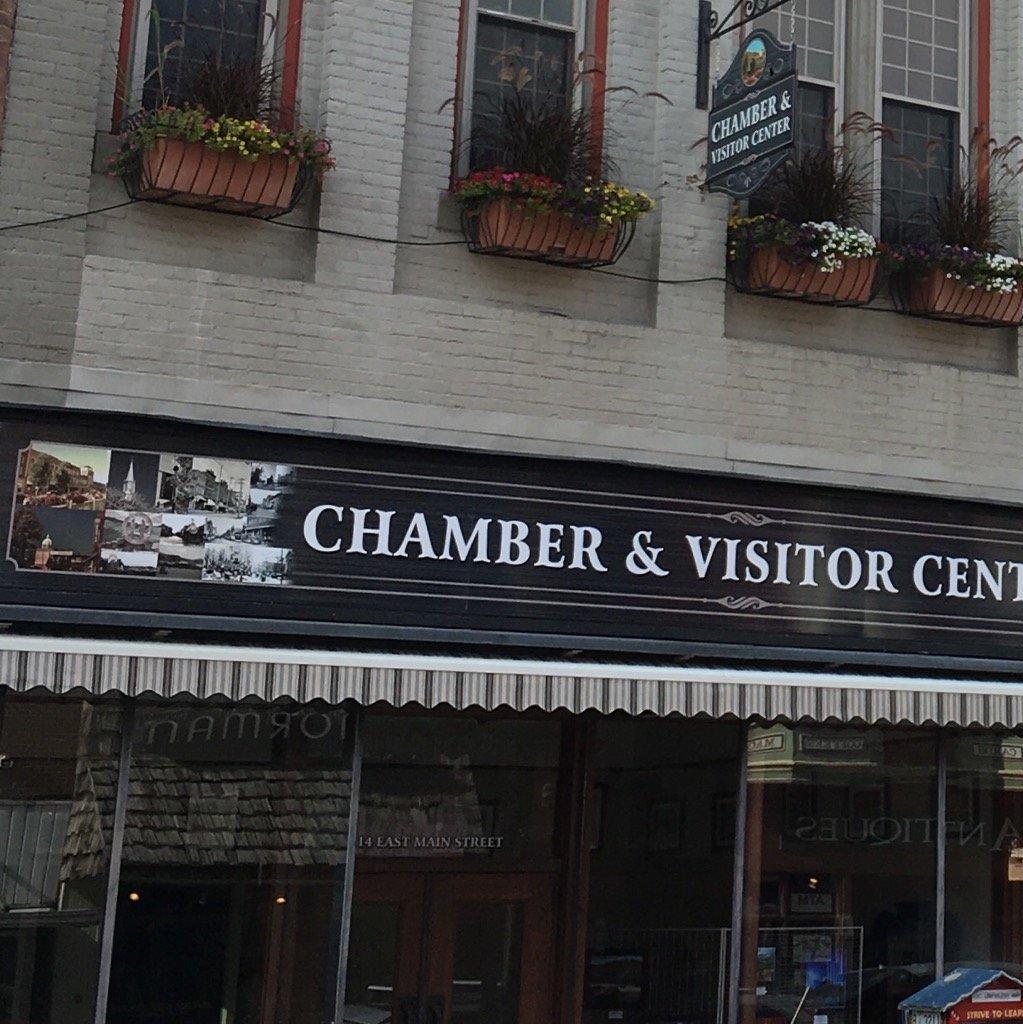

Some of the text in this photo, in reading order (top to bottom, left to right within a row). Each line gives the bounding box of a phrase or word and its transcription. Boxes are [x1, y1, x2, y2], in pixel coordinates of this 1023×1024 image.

[711, 90, 792, 143] CHAMBER &
[711, 116, 791, 165] VISITOR CENTER
[303, 505, 608, 573] CHAMBER
[625, 530, 670, 576] &
[685, 535, 899, 593] VISITOR
[377, 836, 410, 847] EAST
[414, 836, 450, 847] MAIN
[454, 836, 504, 848] STREET
[966, 1010, 990, 1020] STRIVE
[992, 1010, 1003, 1019] TO
